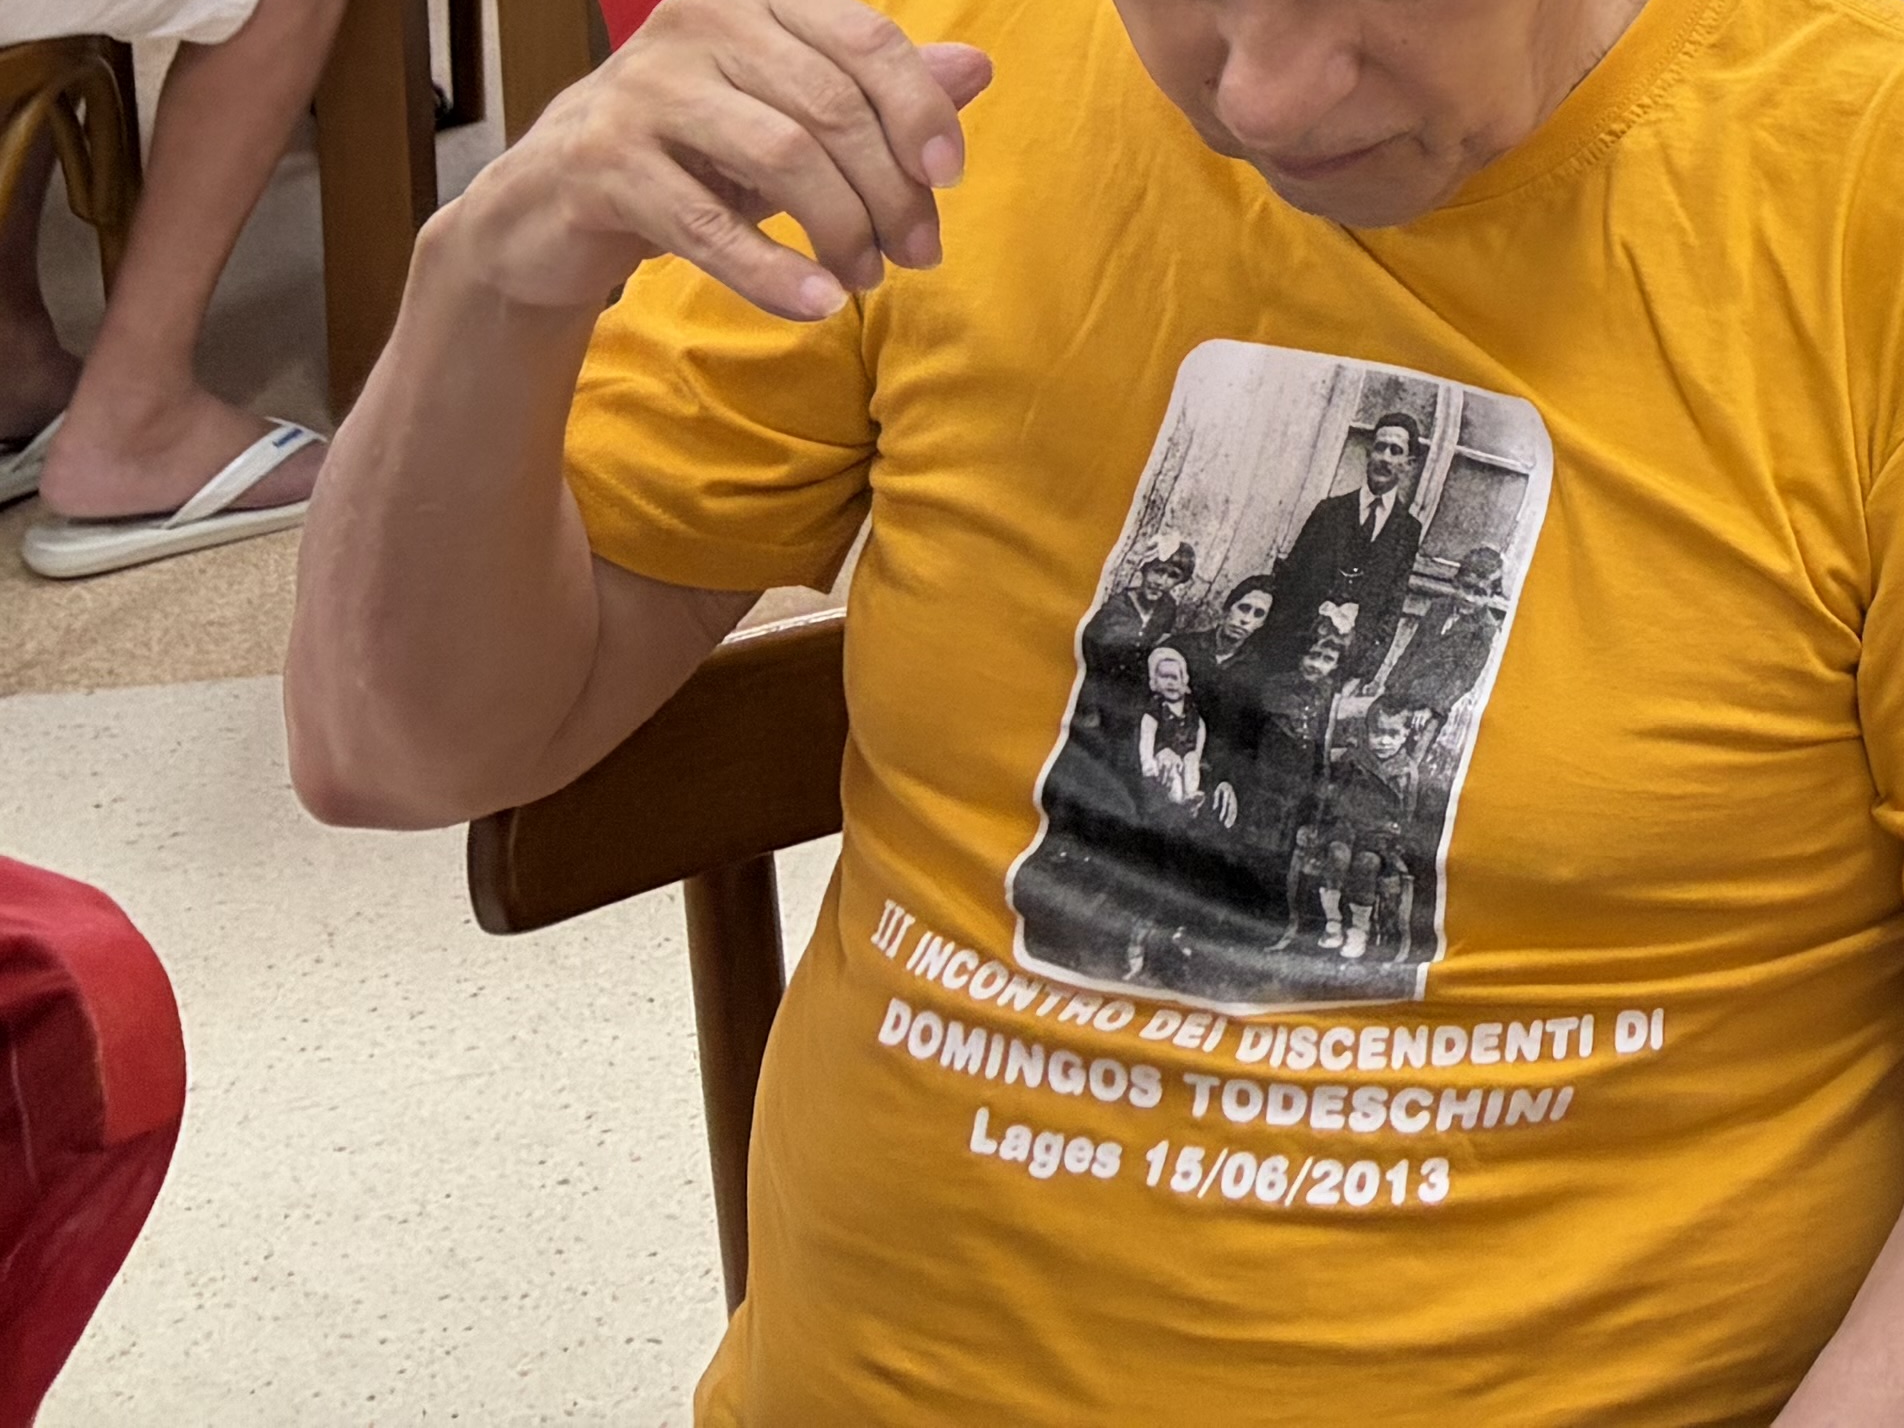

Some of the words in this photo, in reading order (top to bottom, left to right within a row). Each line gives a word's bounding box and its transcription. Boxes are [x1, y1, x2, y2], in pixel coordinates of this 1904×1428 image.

[870, 898, 916, 959] III
[906, 930, 1136, 1032] INCONTRO
[1139, 1009, 1228, 1053] DEI
[1235, 1013, 1595, 1071] DISCENDENTI
[1614, 1007, 1665, 1055] DI
[878, 997, 1163, 1108] DOMINGOS
[1182, 1072, 1575, 1133] TODESCHINI
[969, 1106, 1123, 1179] Lages
[1145, 1139, 1450, 1208] 15/06/2013
